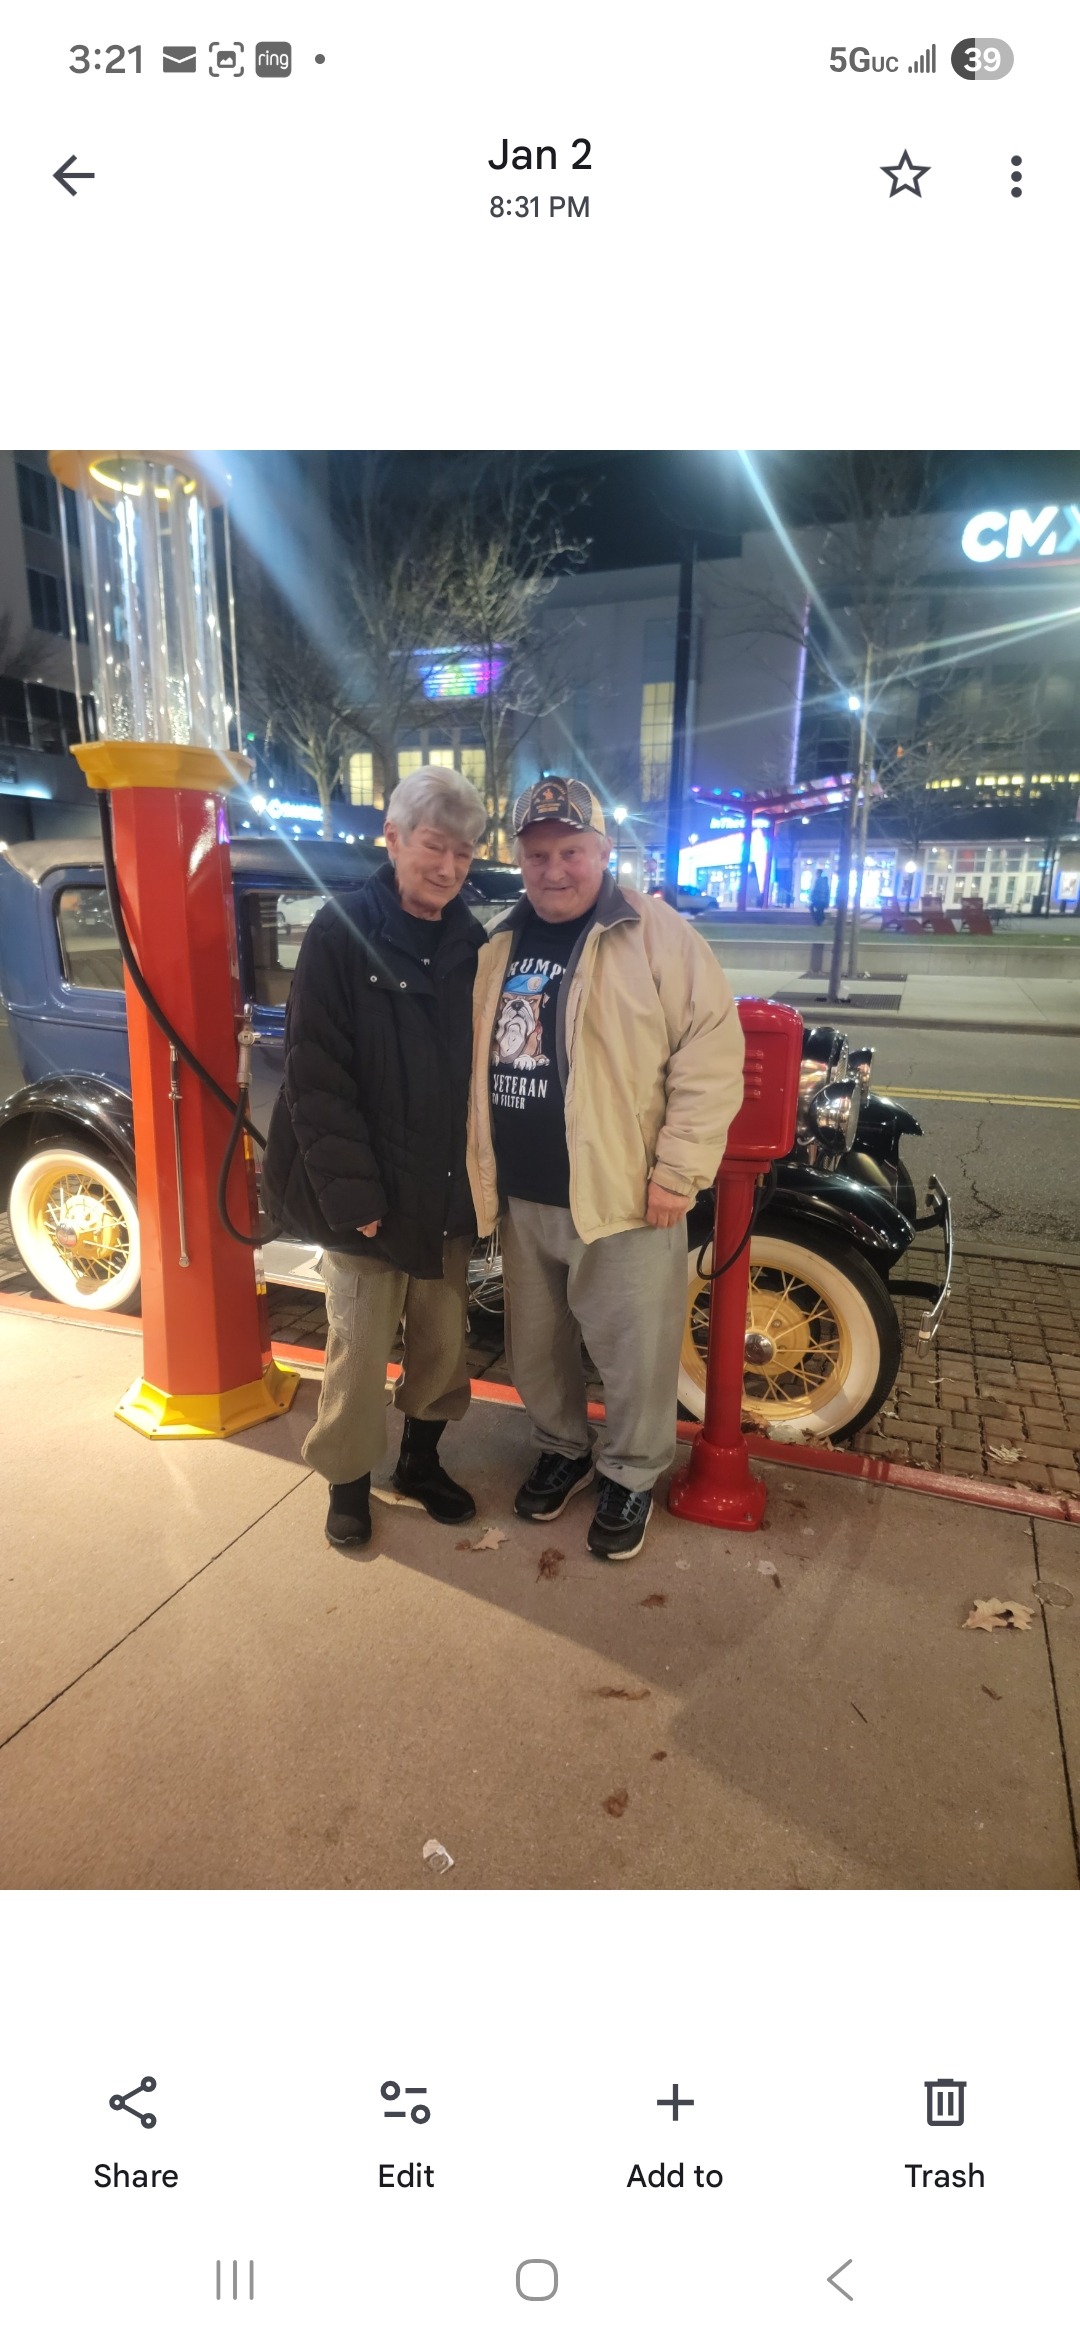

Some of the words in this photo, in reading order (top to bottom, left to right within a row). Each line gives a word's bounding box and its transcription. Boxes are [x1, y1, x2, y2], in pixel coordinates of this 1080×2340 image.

[507, 958, 567, 981] RUMP
[493, 1074, 548, 1099] VETERAN
[500, 1093, 526, 1110] FILTER
